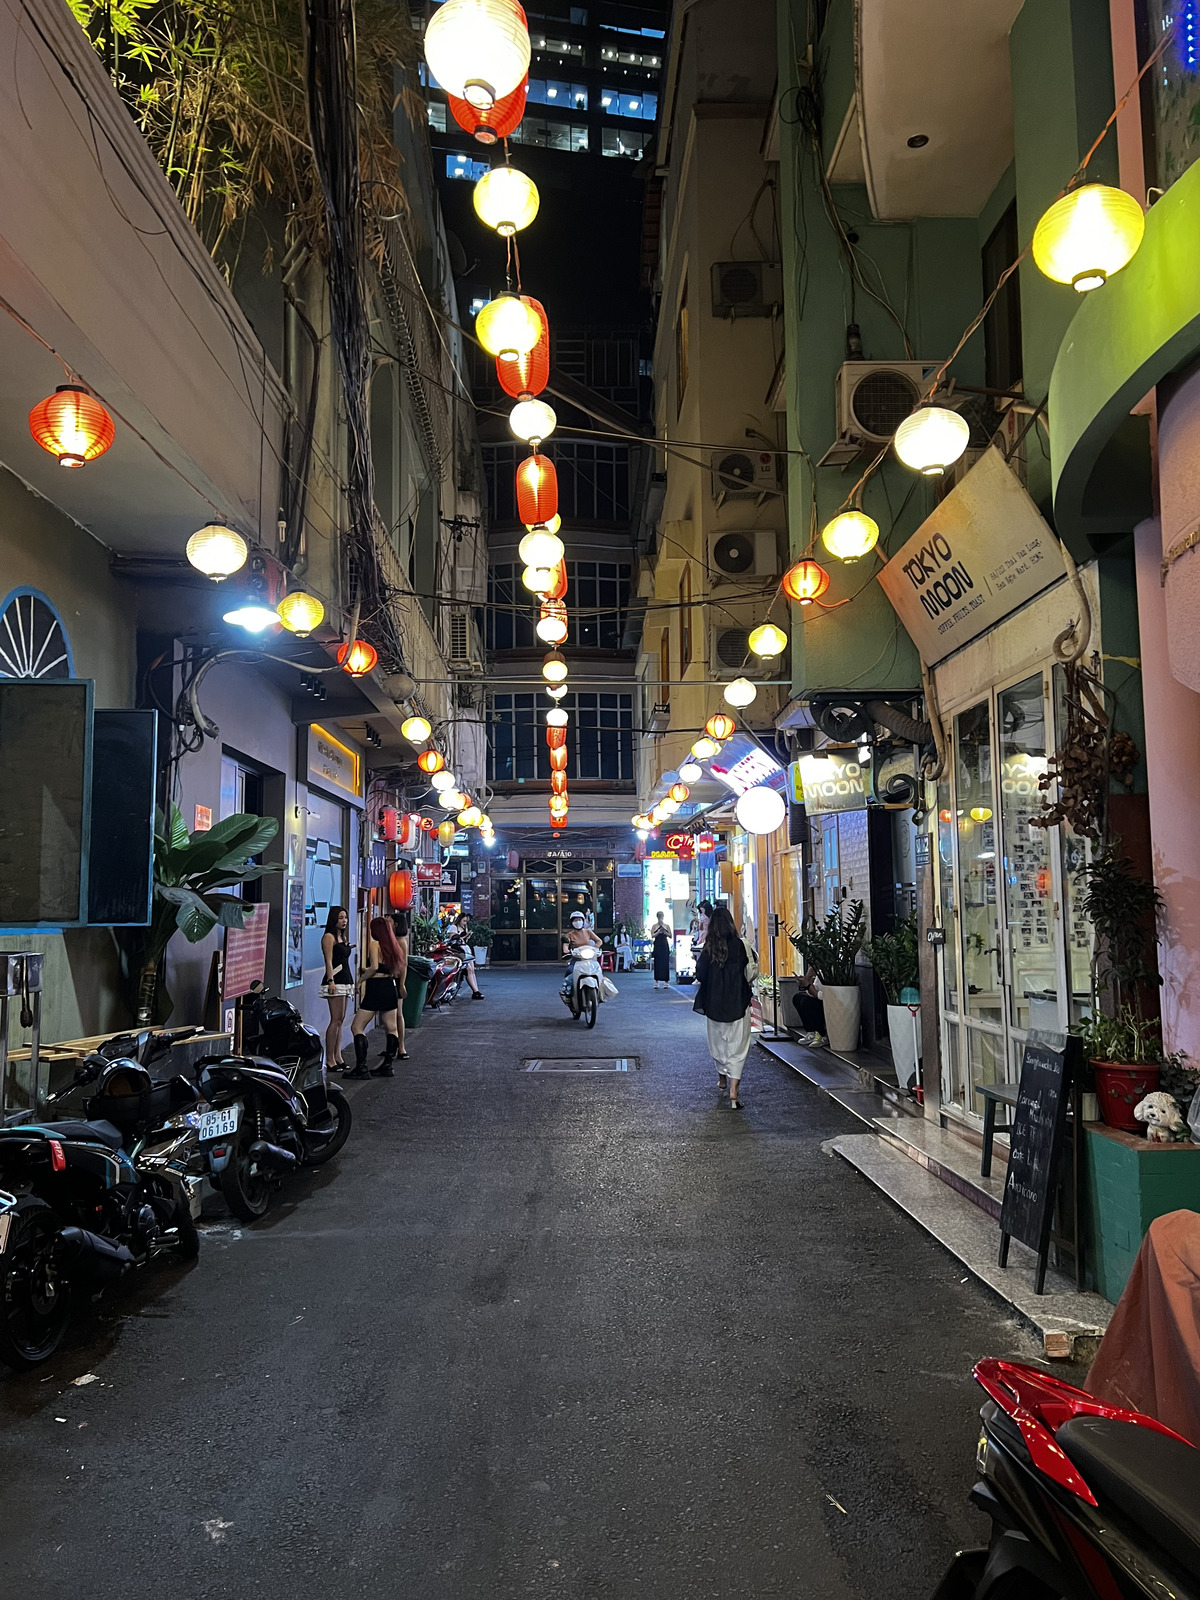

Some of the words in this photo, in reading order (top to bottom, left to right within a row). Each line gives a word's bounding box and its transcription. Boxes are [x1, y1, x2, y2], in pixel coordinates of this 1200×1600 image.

[902, 532, 952, 590] TOKYO
[1005, 556, 1017, 568] Thai
[1016, 549, 1027, 559] Van
[919, 560, 974, 620] MOON
[803, 779, 864, 798] MOON
[206, 1110, 231, 1126] 85-G1
[202, 1120, 235, 1138] 061.69
